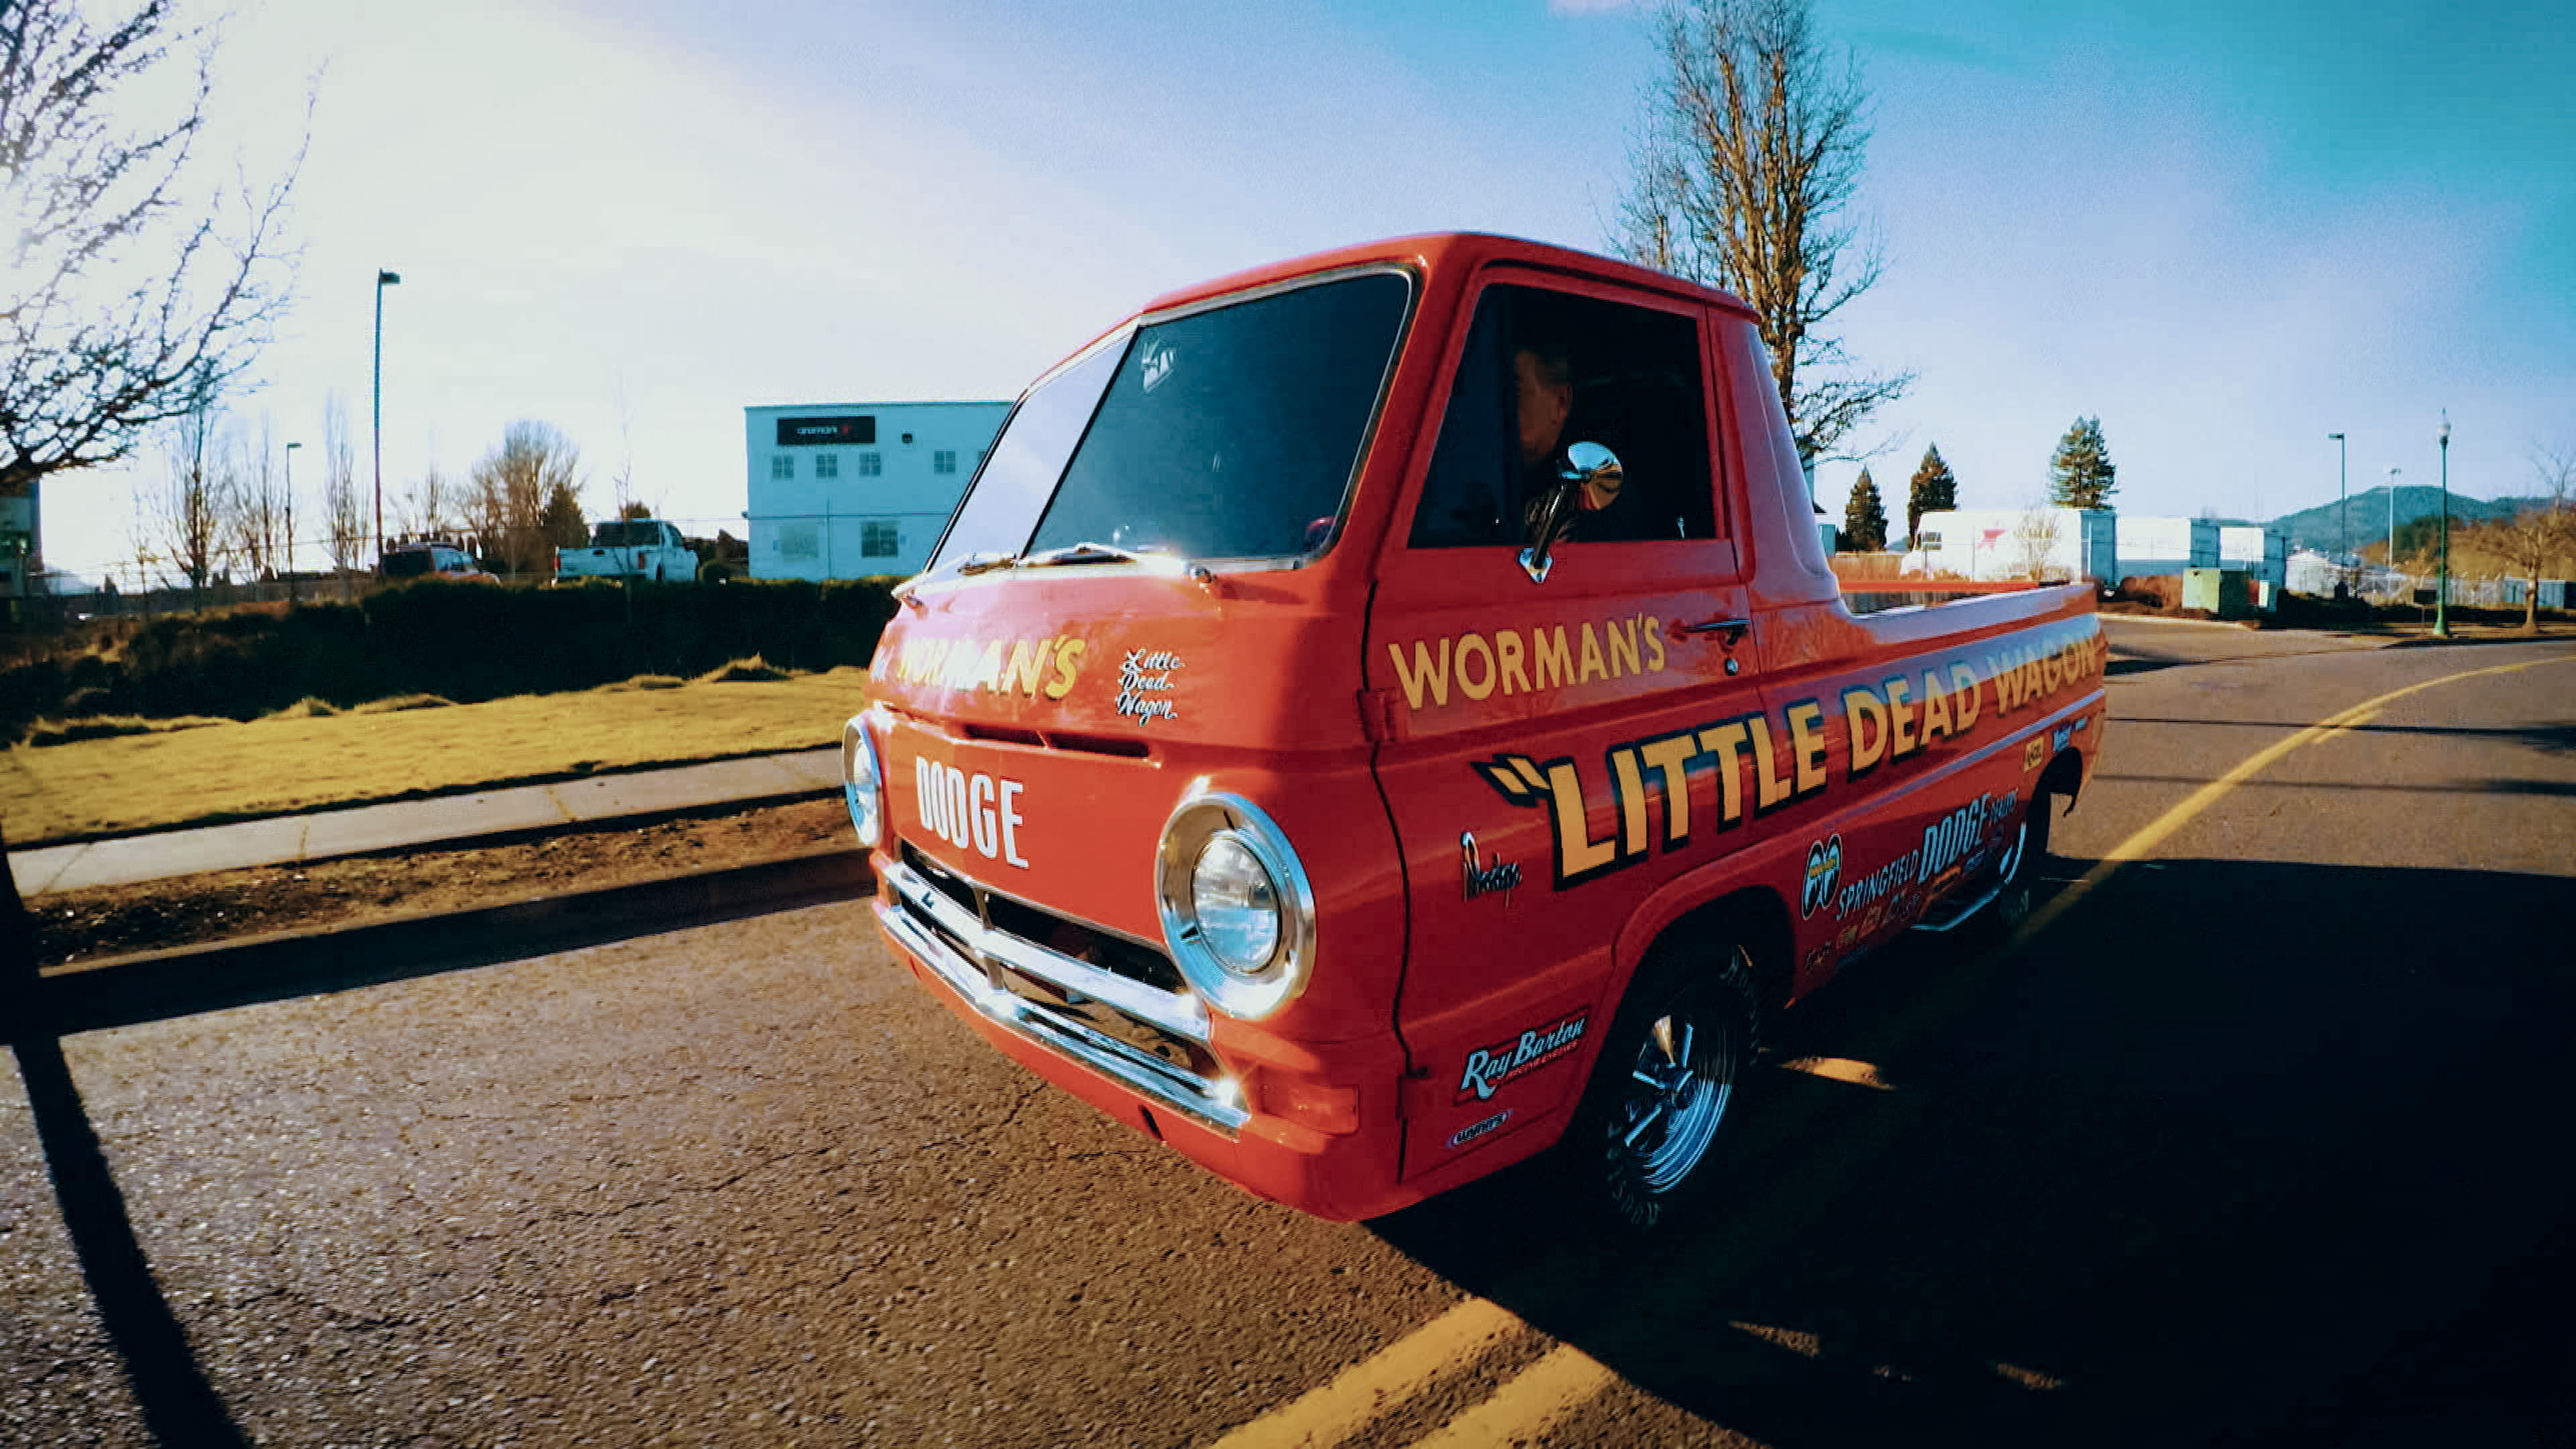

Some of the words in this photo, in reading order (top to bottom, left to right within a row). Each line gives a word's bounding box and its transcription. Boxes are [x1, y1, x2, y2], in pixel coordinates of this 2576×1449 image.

[1117, 669, 1175, 692] Dead
[1119, 647, 1186, 672] Little
[1388, 612, 1665, 710] WORMAN'S
[1114, 690, 1179, 728] Wagon
[1841, 660, 1982, 780] DEAD
[915, 755, 1030, 869] DODGE
[1835, 849, 1920, 922] SPRINGFIELD
[1917, 792, 1992, 886] DODGE
[1460, 1049, 1513, 1099] Ray
[1511, 1017, 1585, 1068] Barton
